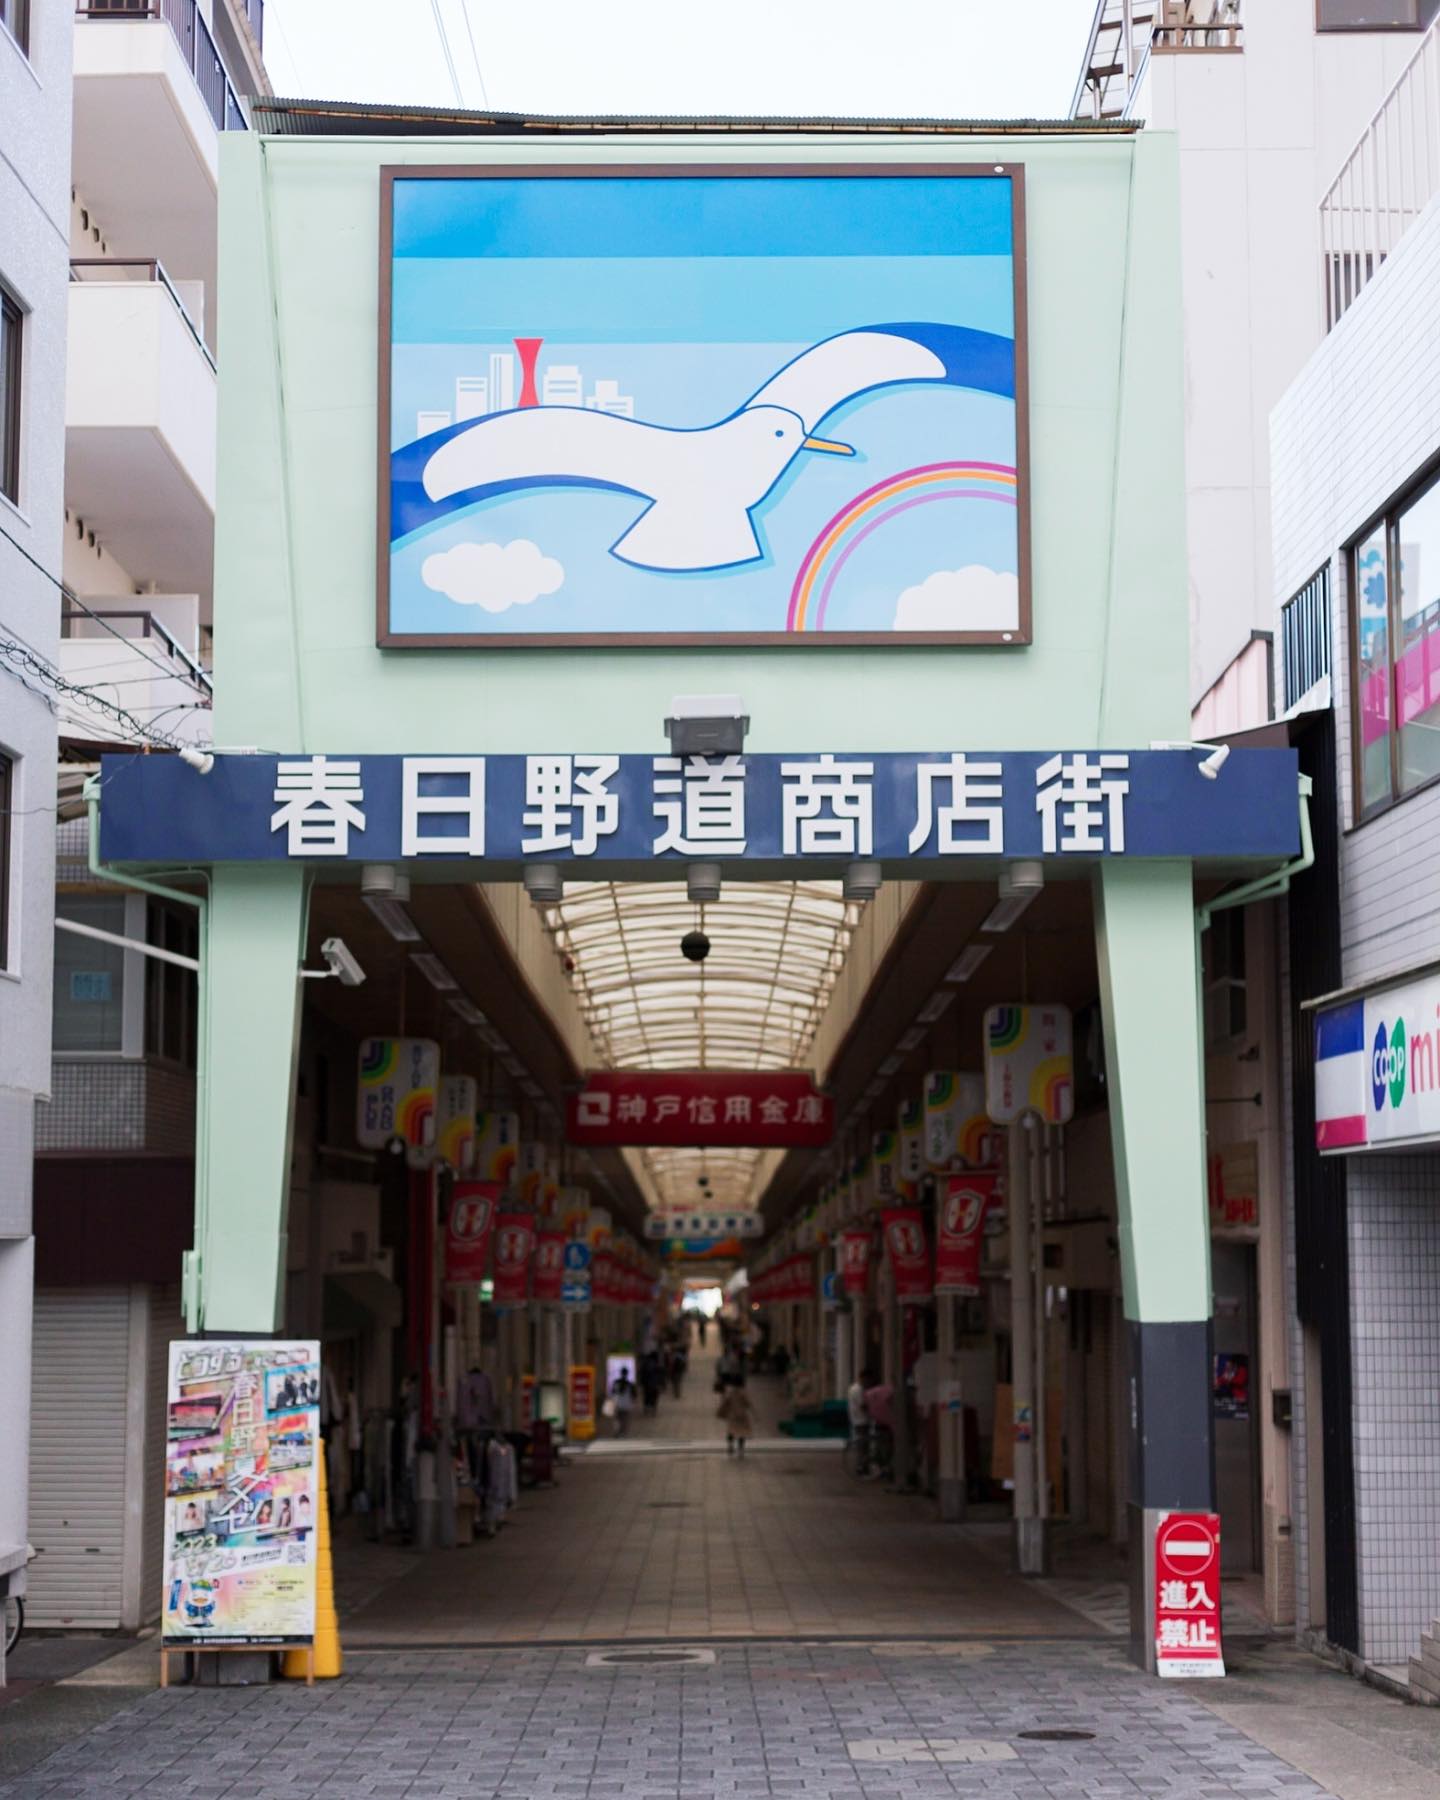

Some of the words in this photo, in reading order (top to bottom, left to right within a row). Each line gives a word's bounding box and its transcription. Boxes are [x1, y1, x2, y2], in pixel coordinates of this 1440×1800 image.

[270, 754, 1130, 857] 春日野道商店街
[616, 1094, 825, 1124] 神戸信用金庫
[1160, 1580, 1215, 1610] 進入
[1160, 1618, 1216, 1648] 禁止
